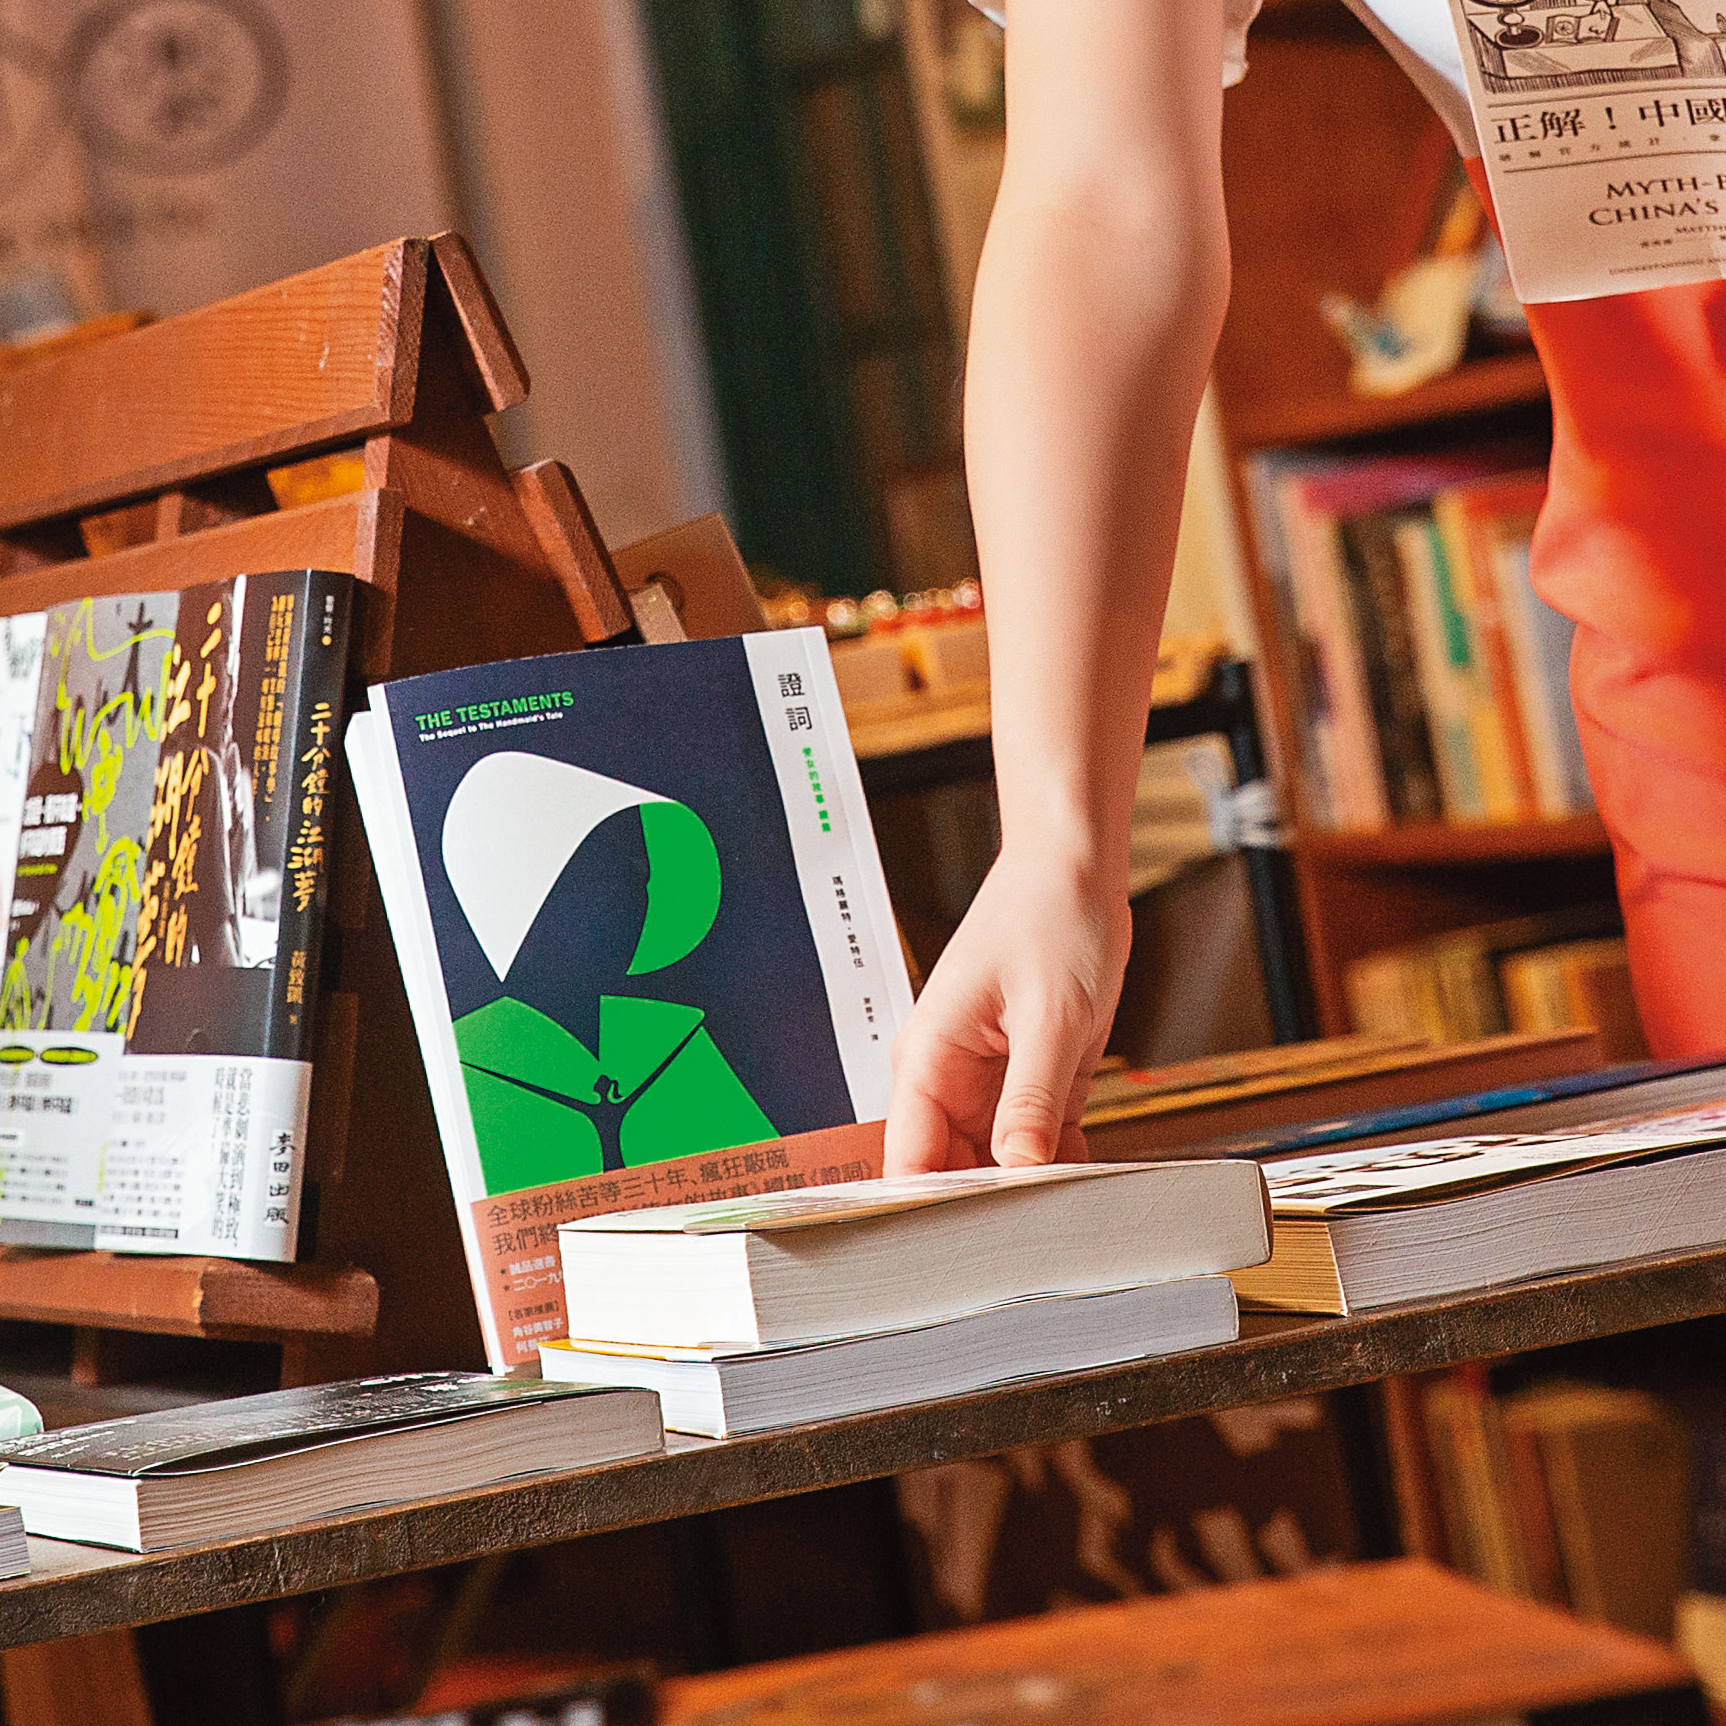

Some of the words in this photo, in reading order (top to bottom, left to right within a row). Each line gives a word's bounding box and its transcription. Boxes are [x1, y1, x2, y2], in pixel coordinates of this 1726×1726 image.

[1589, 199, 1720, 225] CHINA'S
[415, 710, 453, 731] THE
[456, 691, 574, 722] TESTAMENTS
[778, 672, 813, 731] 證詞
[264, 1132, 296, 1225] 麥田出版
